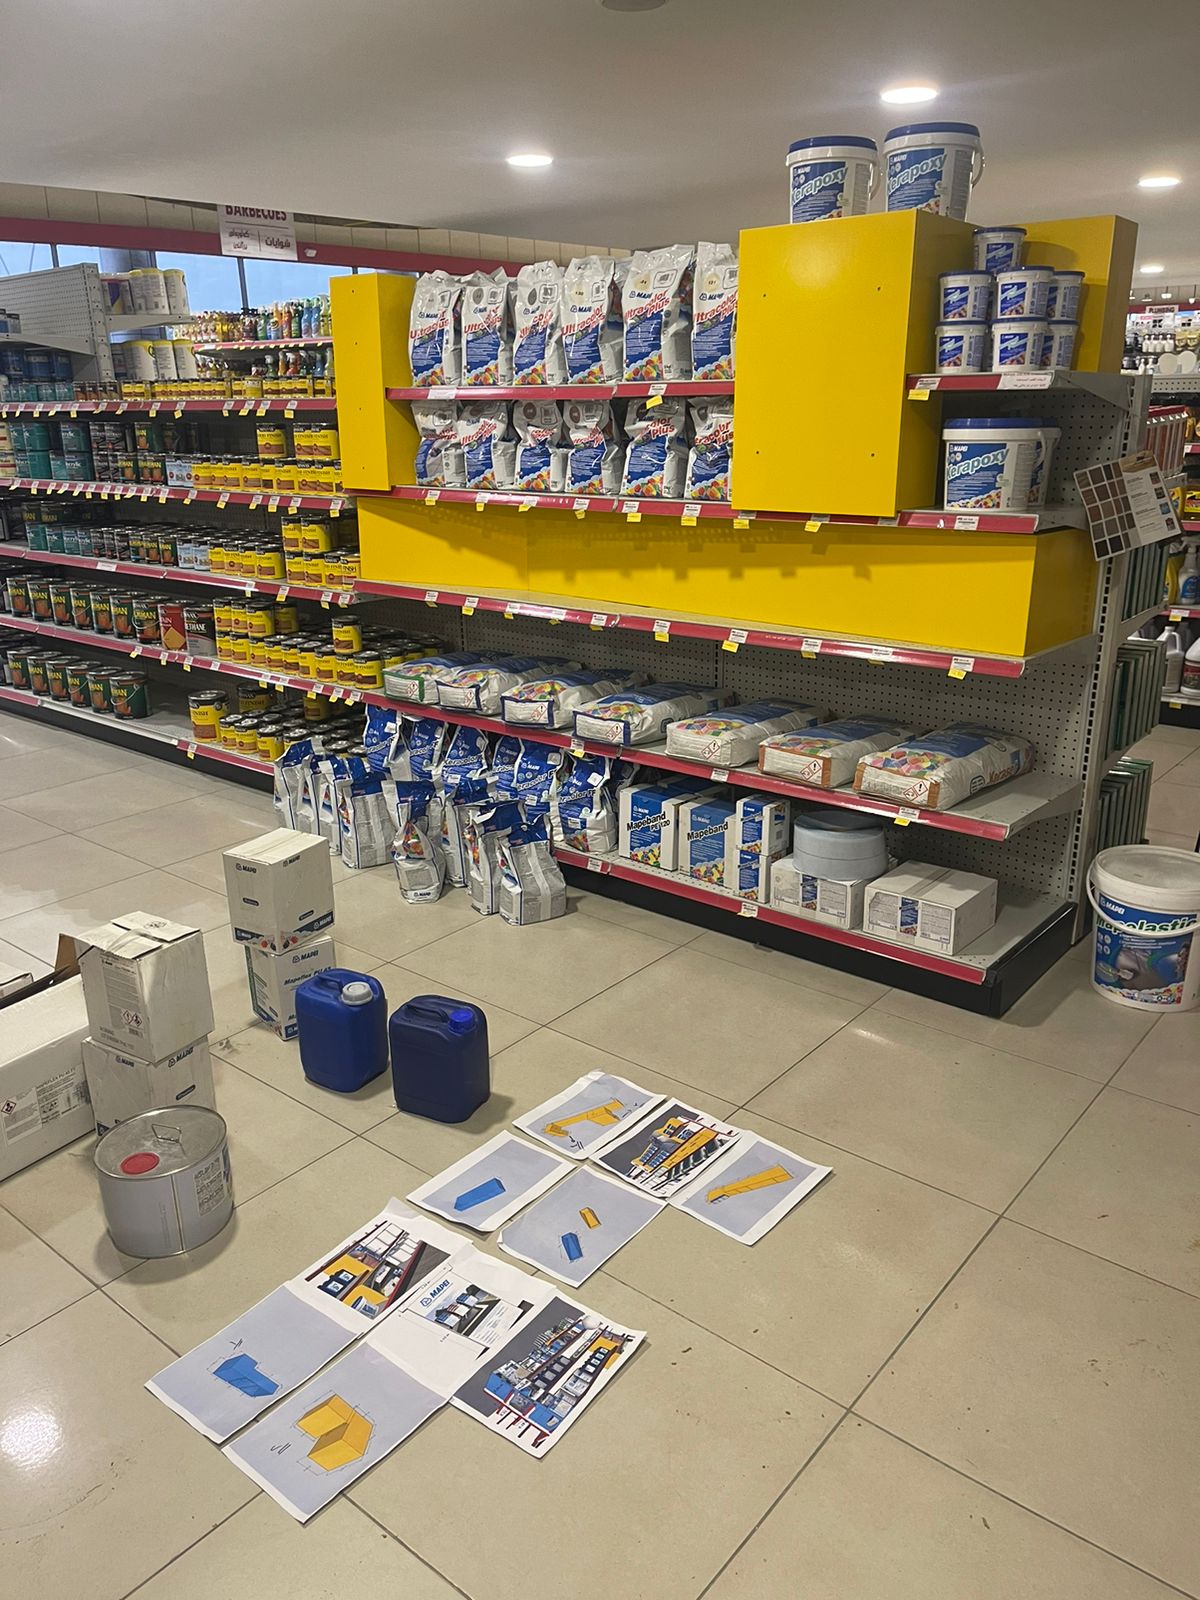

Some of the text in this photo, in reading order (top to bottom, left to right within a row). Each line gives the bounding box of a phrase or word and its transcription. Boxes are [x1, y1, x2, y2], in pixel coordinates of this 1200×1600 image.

[1148, 306, 1175, 314] PLUMBING
[626, 811, 667, 832] Mapeband
[687, 822, 730, 842] Mapeband
[300, 950, 319, 961] MAPEI
[429, 1278, 451, 1300] MAPEI
